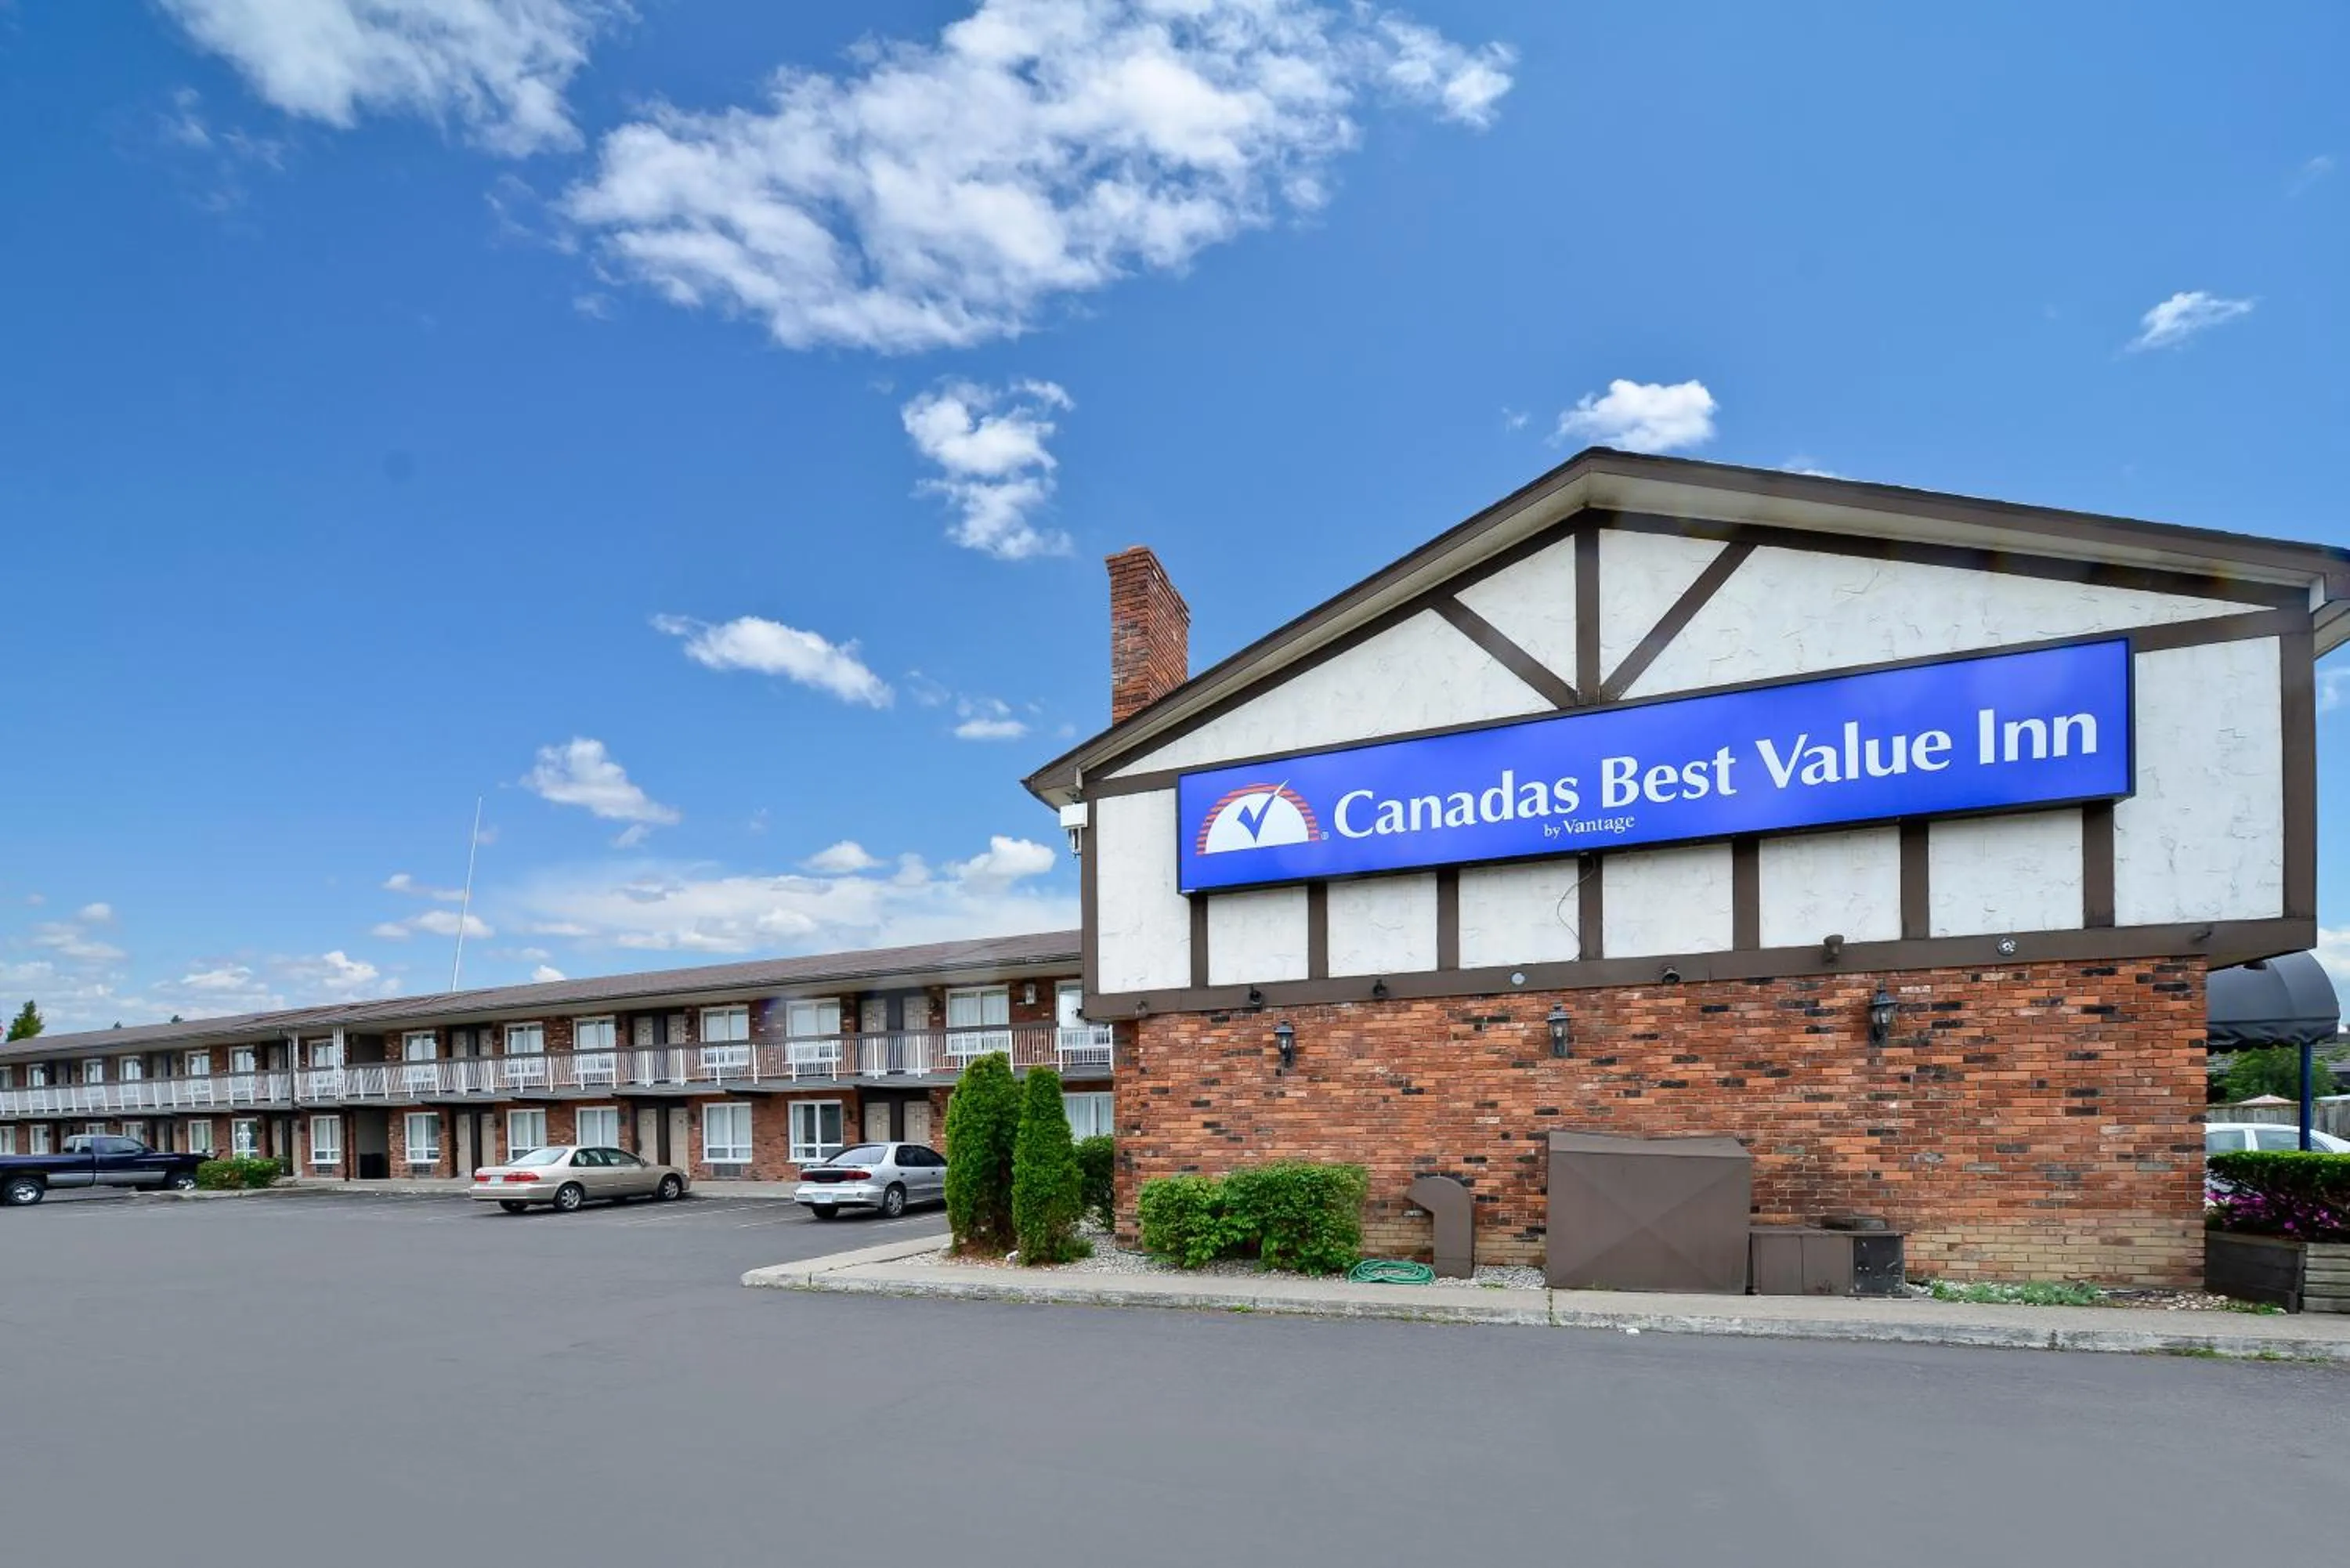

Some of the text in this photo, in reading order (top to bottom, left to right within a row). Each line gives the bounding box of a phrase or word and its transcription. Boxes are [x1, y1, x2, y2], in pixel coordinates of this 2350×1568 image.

[1333, 708, 2098, 839] Canadas Best Value Inn
[1543, 815, 1636, 839] by Vantage
